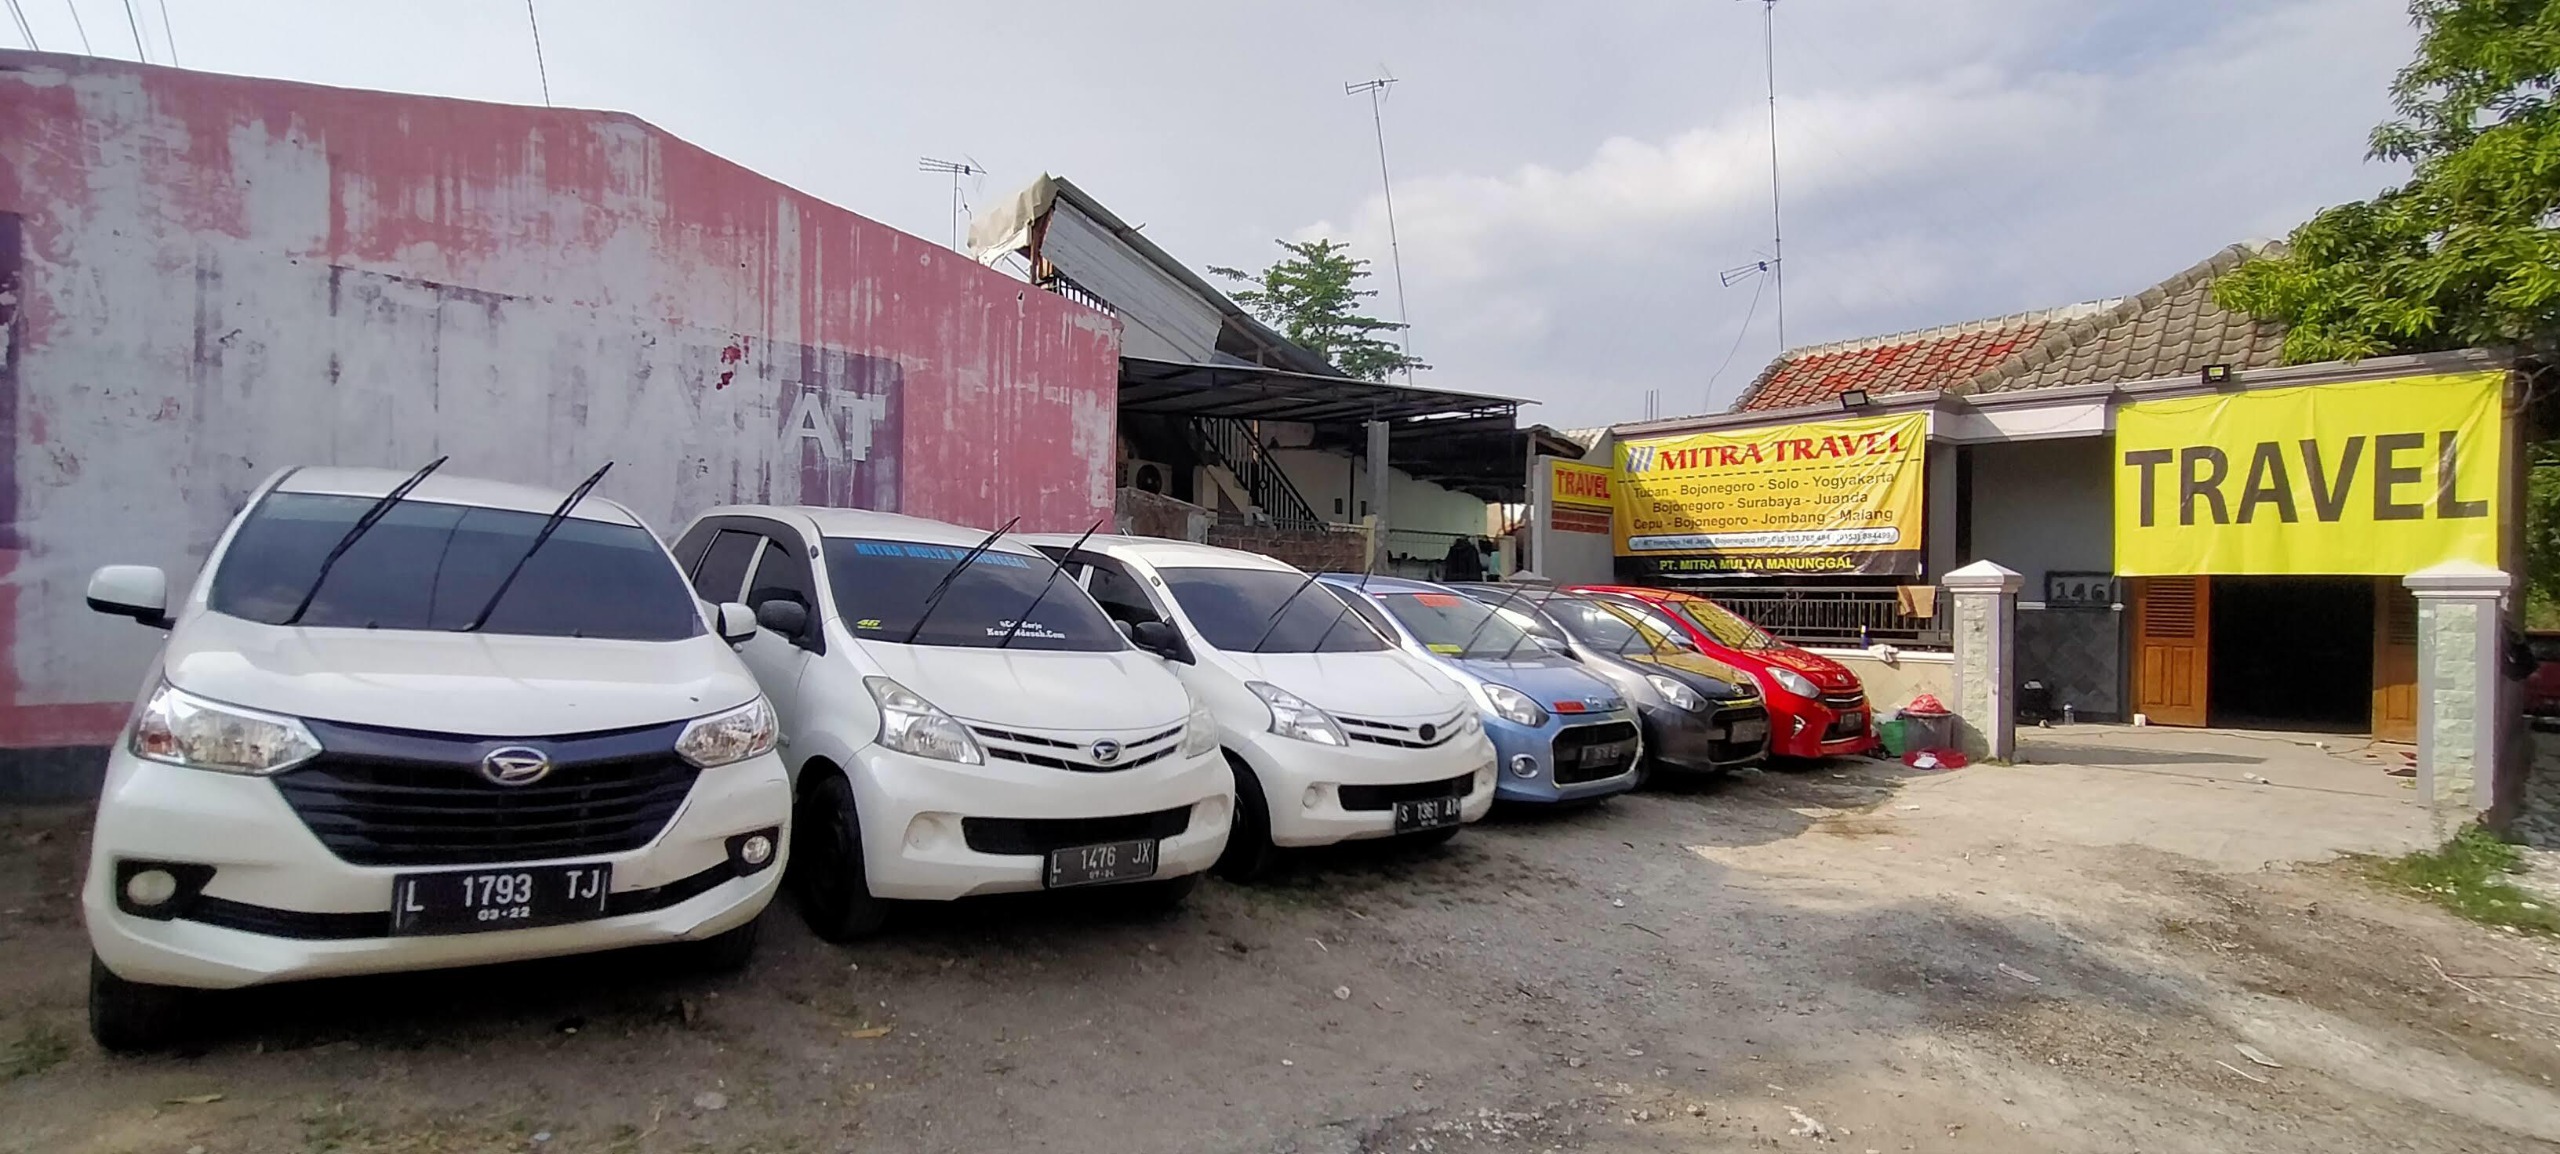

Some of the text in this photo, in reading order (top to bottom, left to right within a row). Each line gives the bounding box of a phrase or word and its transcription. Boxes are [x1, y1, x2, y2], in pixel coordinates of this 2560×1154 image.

[1660, 431, 1907, 471] MITRA TRAVEL
[1556, 470, 1611, 499] TRAVEL
[1634, 488, 1669, 498] Tuban
[1680, 482, 1755, 497] Bojonegoro
[1768, 478, 1799, 490] Solo
[1812, 473, 1894, 489] Yogyakarta
[2124, 430, 2489, 528] TRAVEL
[1653, 501, 1725, 514] Bojonegoro
[1737, 495, 1801, 510] Surabaya
[1814, 491, 1868, 505] Juanda
[1633, 519, 1663, 531] Cepu
[1674, 515, 1749, 530] Bojonegoro
[1761, 512, 1826, 526] Jombang
[1839, 509, 1893, 522] Malang
[855, 543, 904, 557] MITRA
[1660, 557, 1855, 570] PT. MITRA MULYA MANUNGGAL
[2055, 582, 2105, 601] 146
[1401, 805, 1409, 823] S
[1053, 842, 1151, 874] L 1476 JX
[406, 869, 600, 912] L 1793 TJ
